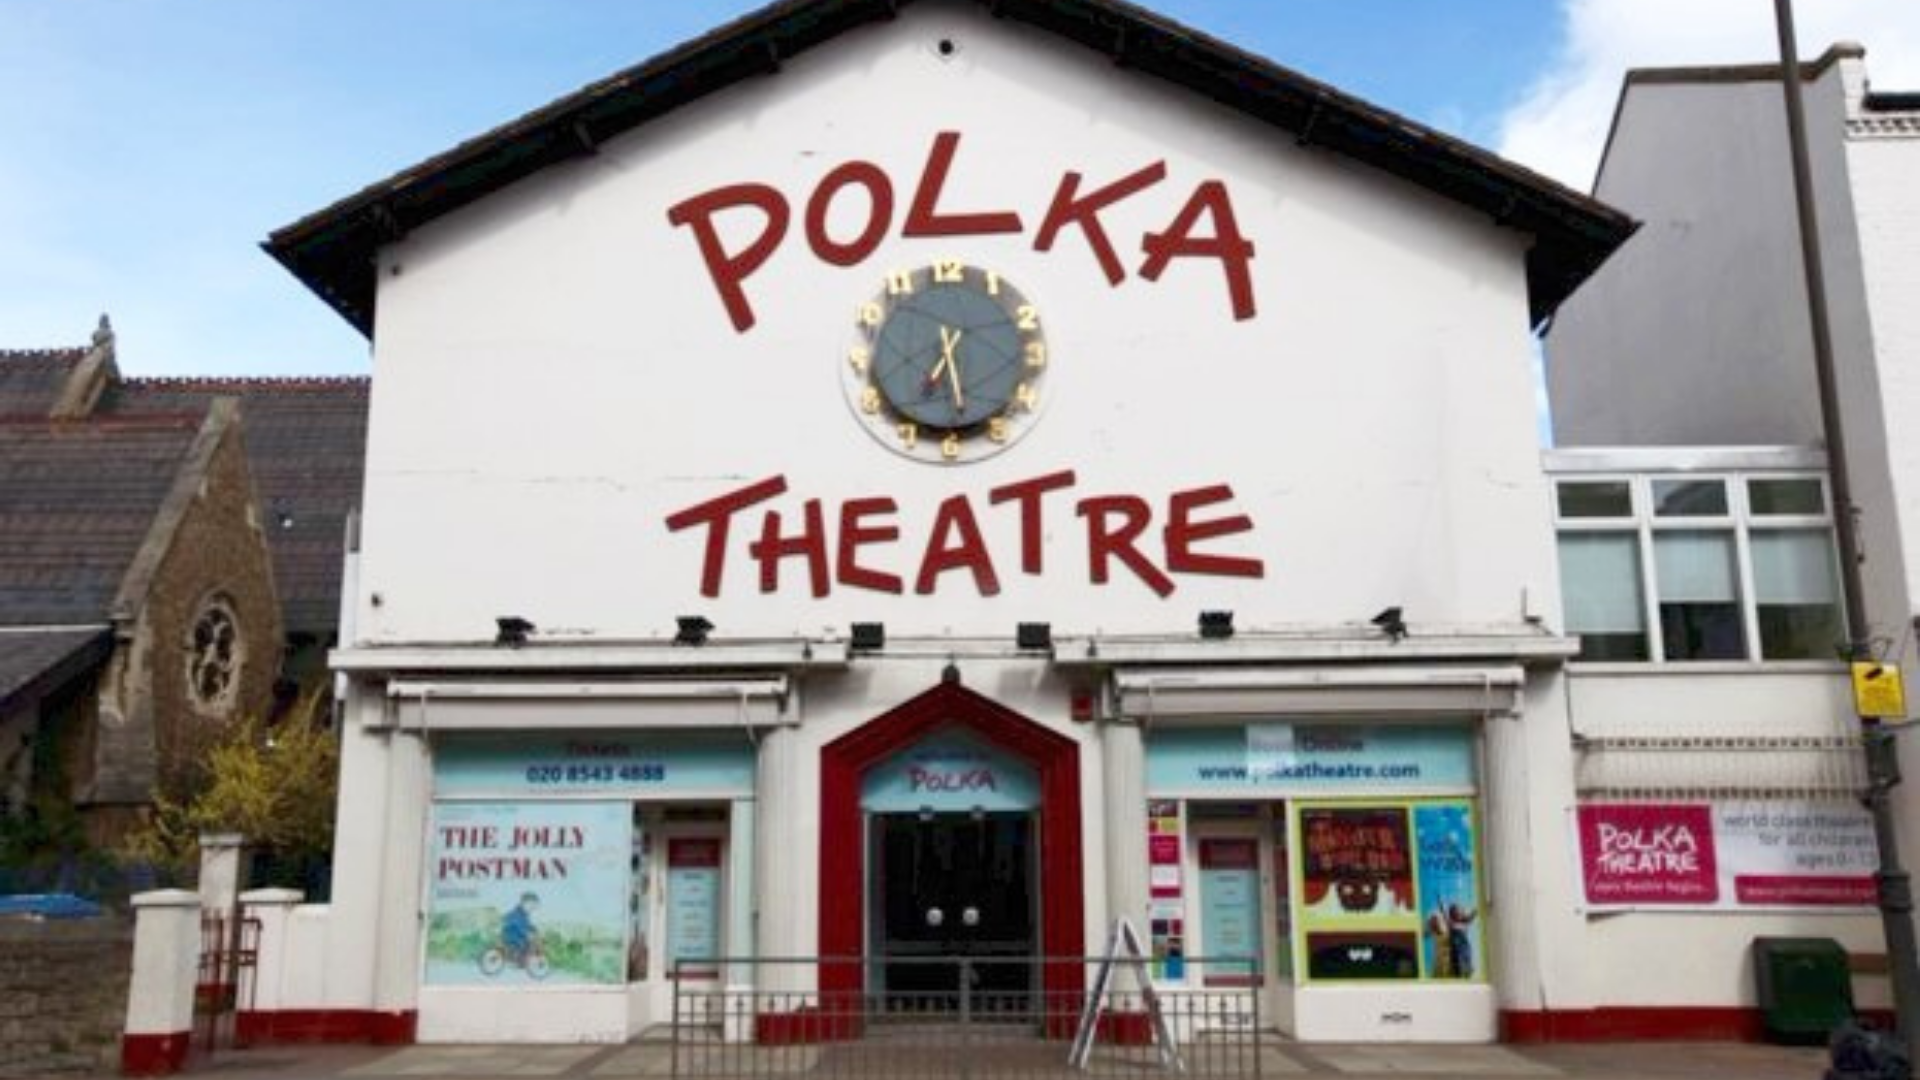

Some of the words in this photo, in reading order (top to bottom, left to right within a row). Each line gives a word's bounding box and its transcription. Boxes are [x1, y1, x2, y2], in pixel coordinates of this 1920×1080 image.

[667, 131, 1256, 333] POLKA
[932, 258, 964, 283] 12
[986, 269, 1000, 295] 1
[1016, 305, 1038, 329] 2
[1025, 341, 1046, 367] 3
[941, 431, 960, 459] 6
[665, 470, 1264, 598] THEATRE
[526, 766, 562, 784] 020
[567, 765, 614, 783] 8543
[908, 768, 996, 792] POLKA
[1199, 761, 1420, 784] wwwlkatheatre.com
[439, 827, 498, 849] THE
[508, 826, 585, 850] JOLLY
[1597, 822, 1698, 852] POLKA
[438, 858, 567, 880] POSTMAN
[1597, 851, 1700, 875] THEATRE
